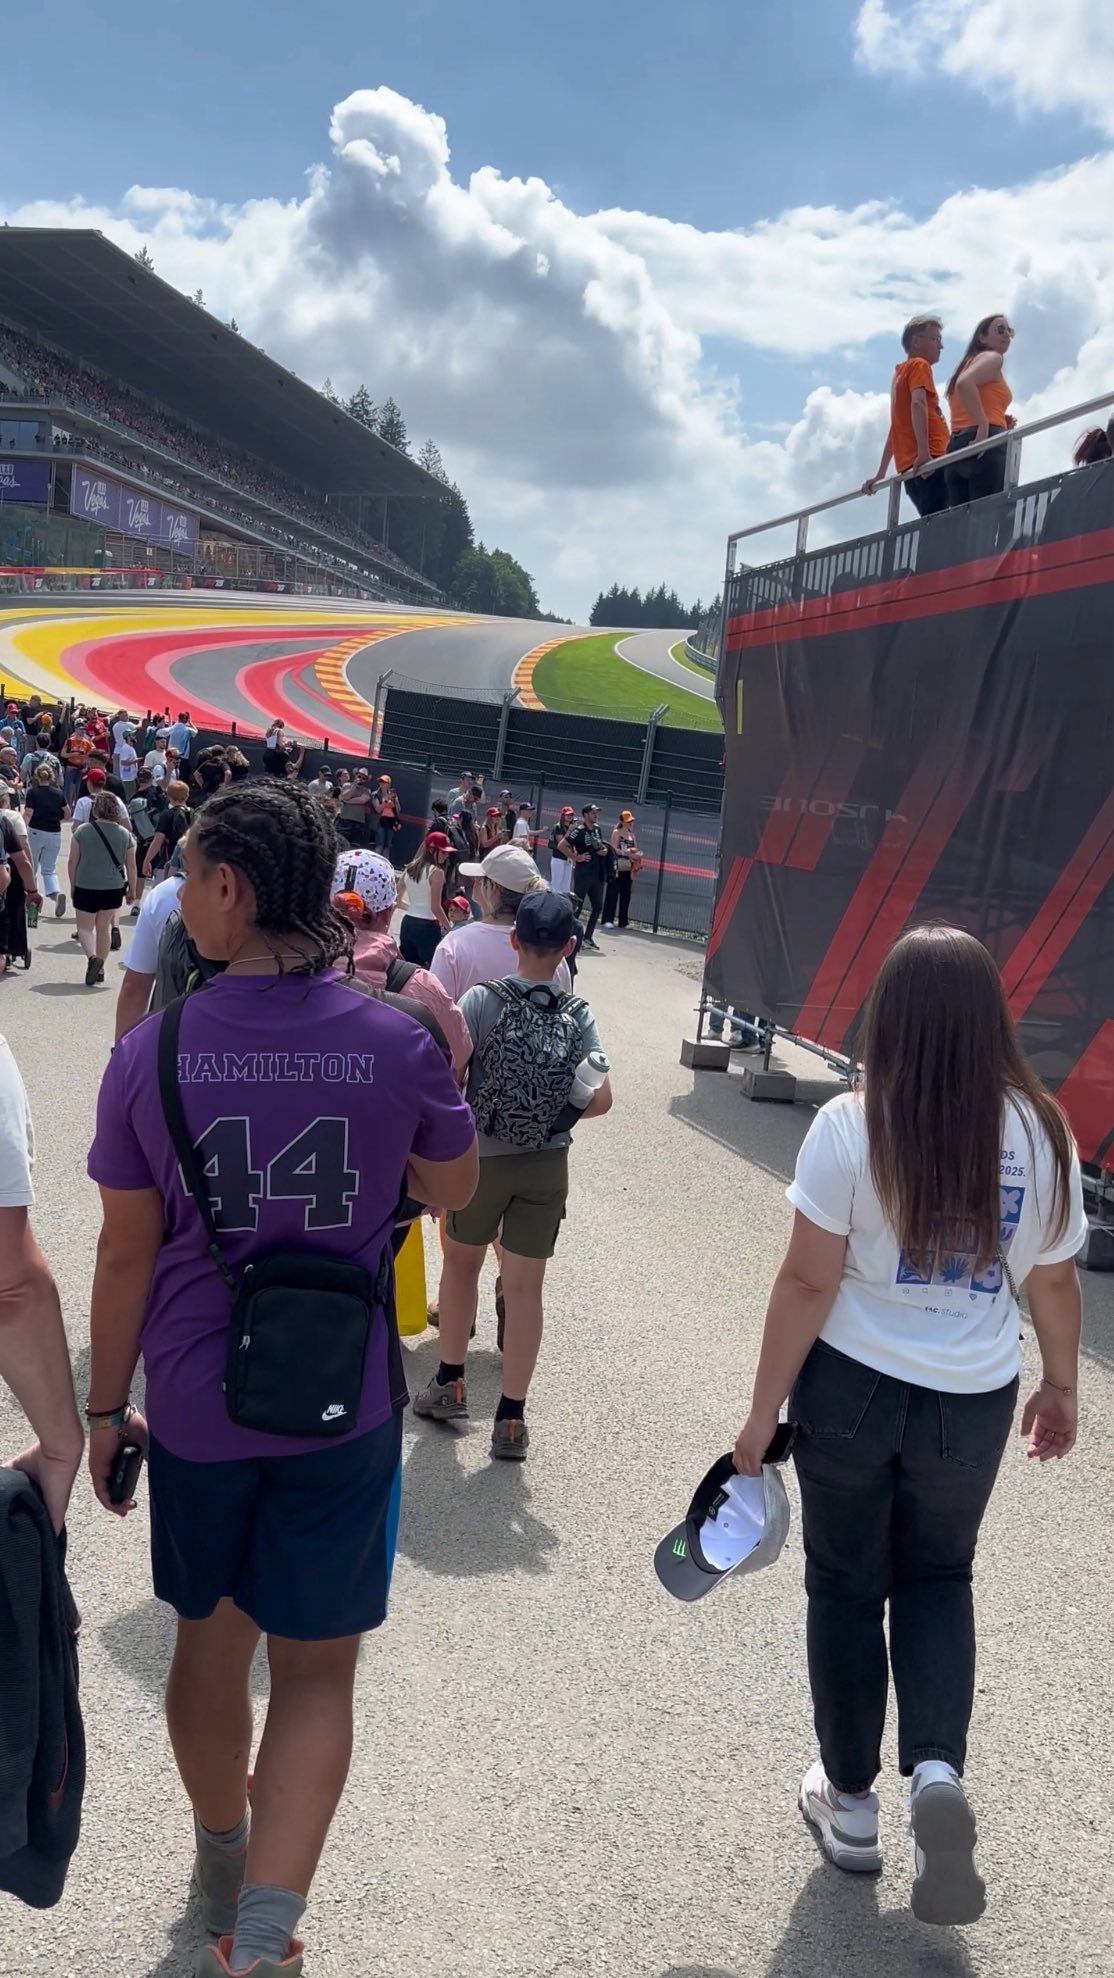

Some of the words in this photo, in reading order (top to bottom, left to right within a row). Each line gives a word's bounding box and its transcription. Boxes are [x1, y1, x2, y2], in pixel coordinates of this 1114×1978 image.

[82, 481, 109, 516] Vegas
[127, 498, 151, 532] Vegas
[167, 515, 189, 547] Vegas
[178, 1116, 360, 1232] 44
[326, 1404, 345, 1414] NIKE
